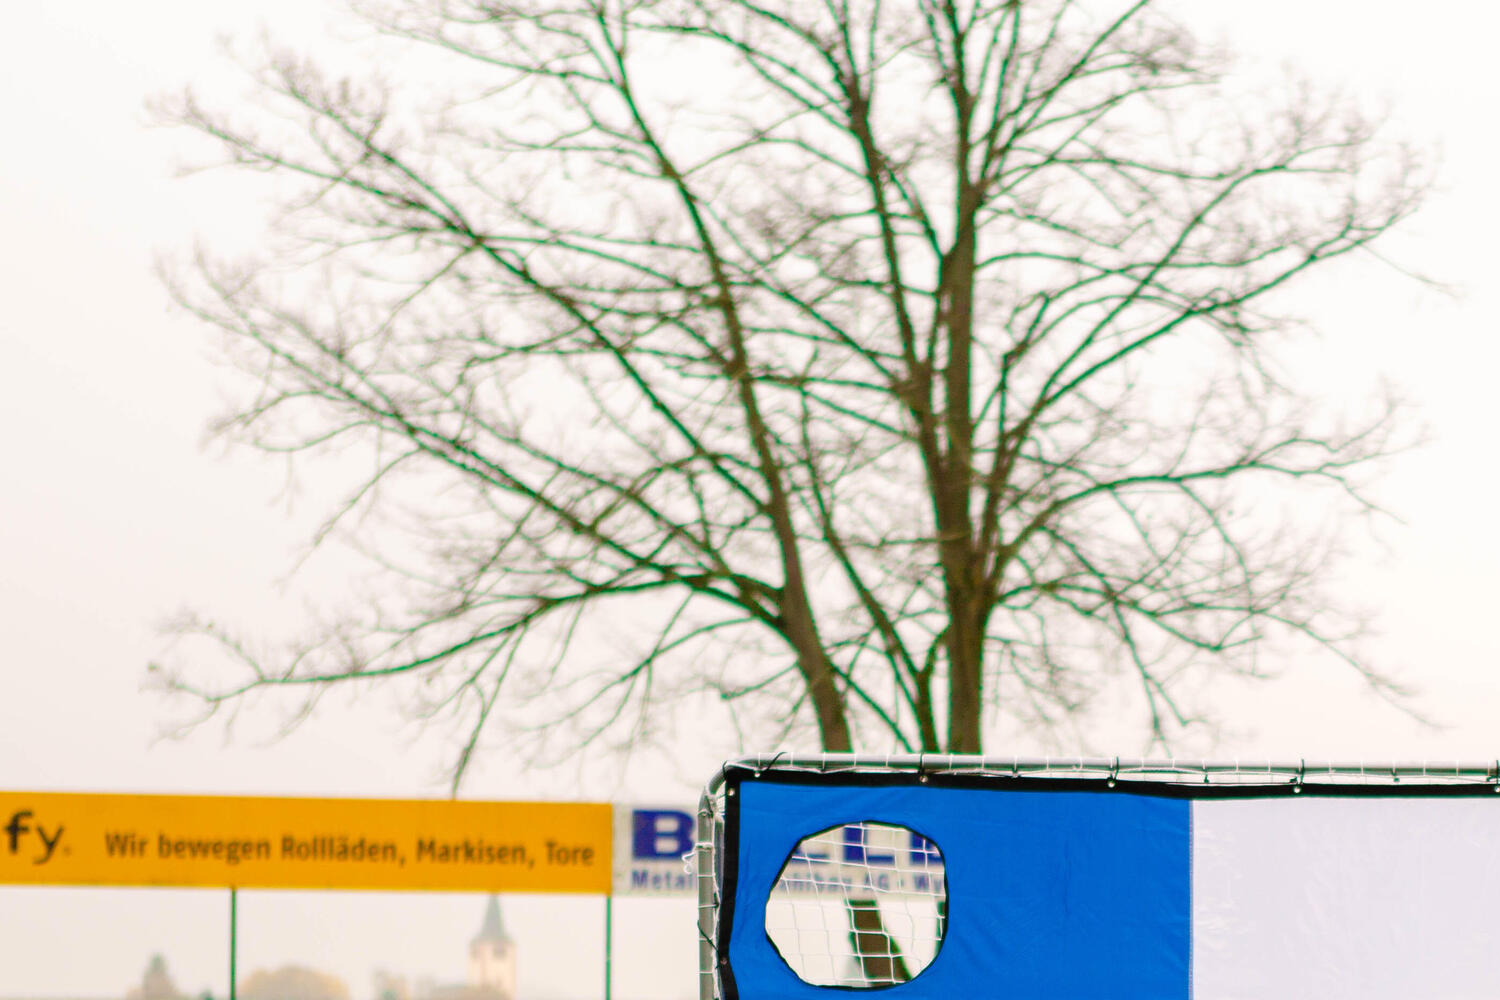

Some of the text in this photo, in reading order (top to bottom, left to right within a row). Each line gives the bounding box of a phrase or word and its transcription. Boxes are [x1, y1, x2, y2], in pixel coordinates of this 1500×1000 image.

[105, 832, 596, 868] Wir bewegen Rollläden, Markisen, Tore
